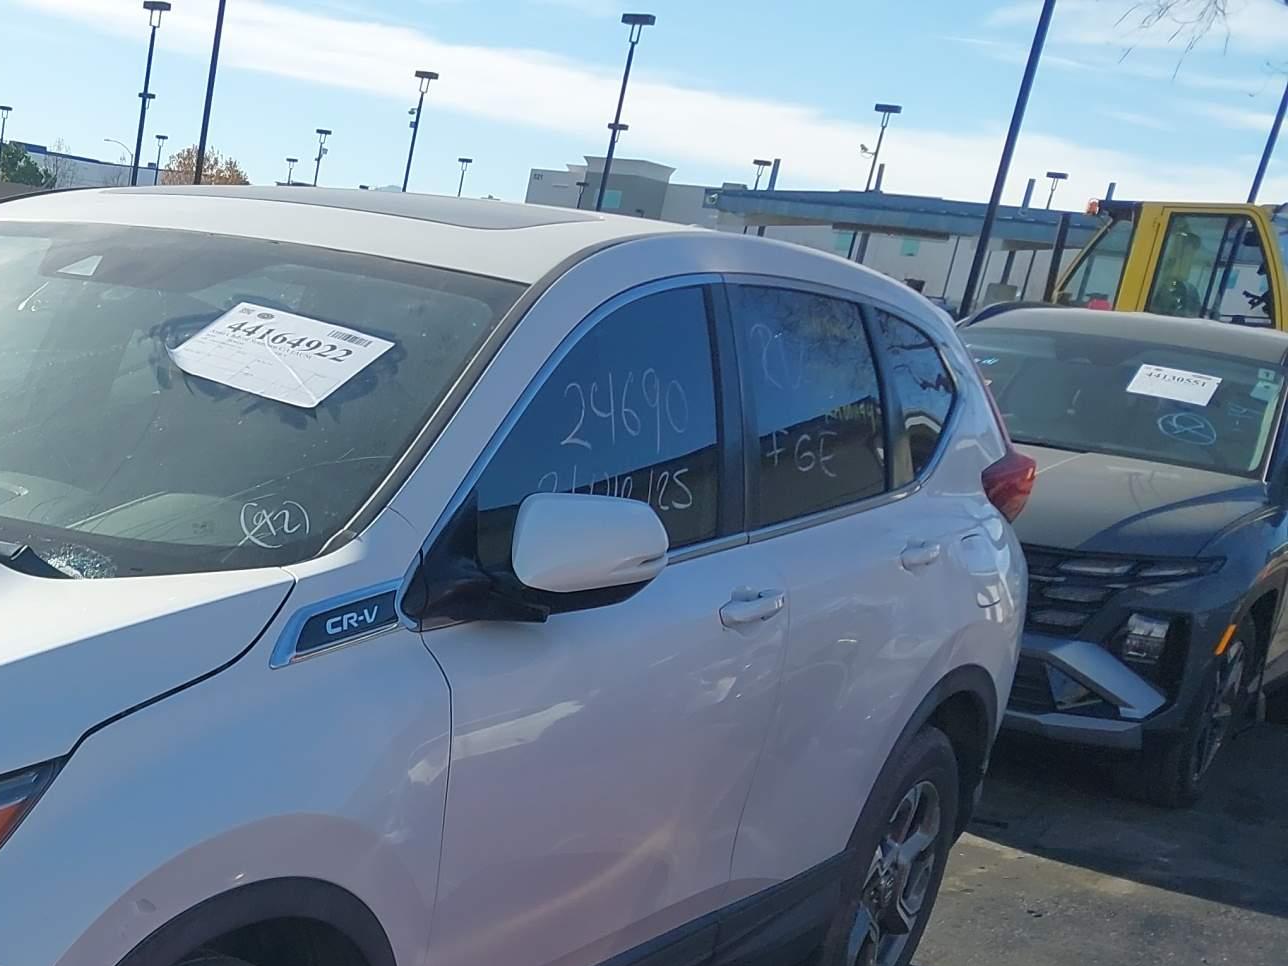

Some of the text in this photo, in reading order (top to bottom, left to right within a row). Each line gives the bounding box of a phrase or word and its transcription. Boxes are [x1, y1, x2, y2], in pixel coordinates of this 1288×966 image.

[227, 320, 354, 363] 44164922
[560, 367, 690, 454] 24690
[325, 605, 379, 635] CR-V
